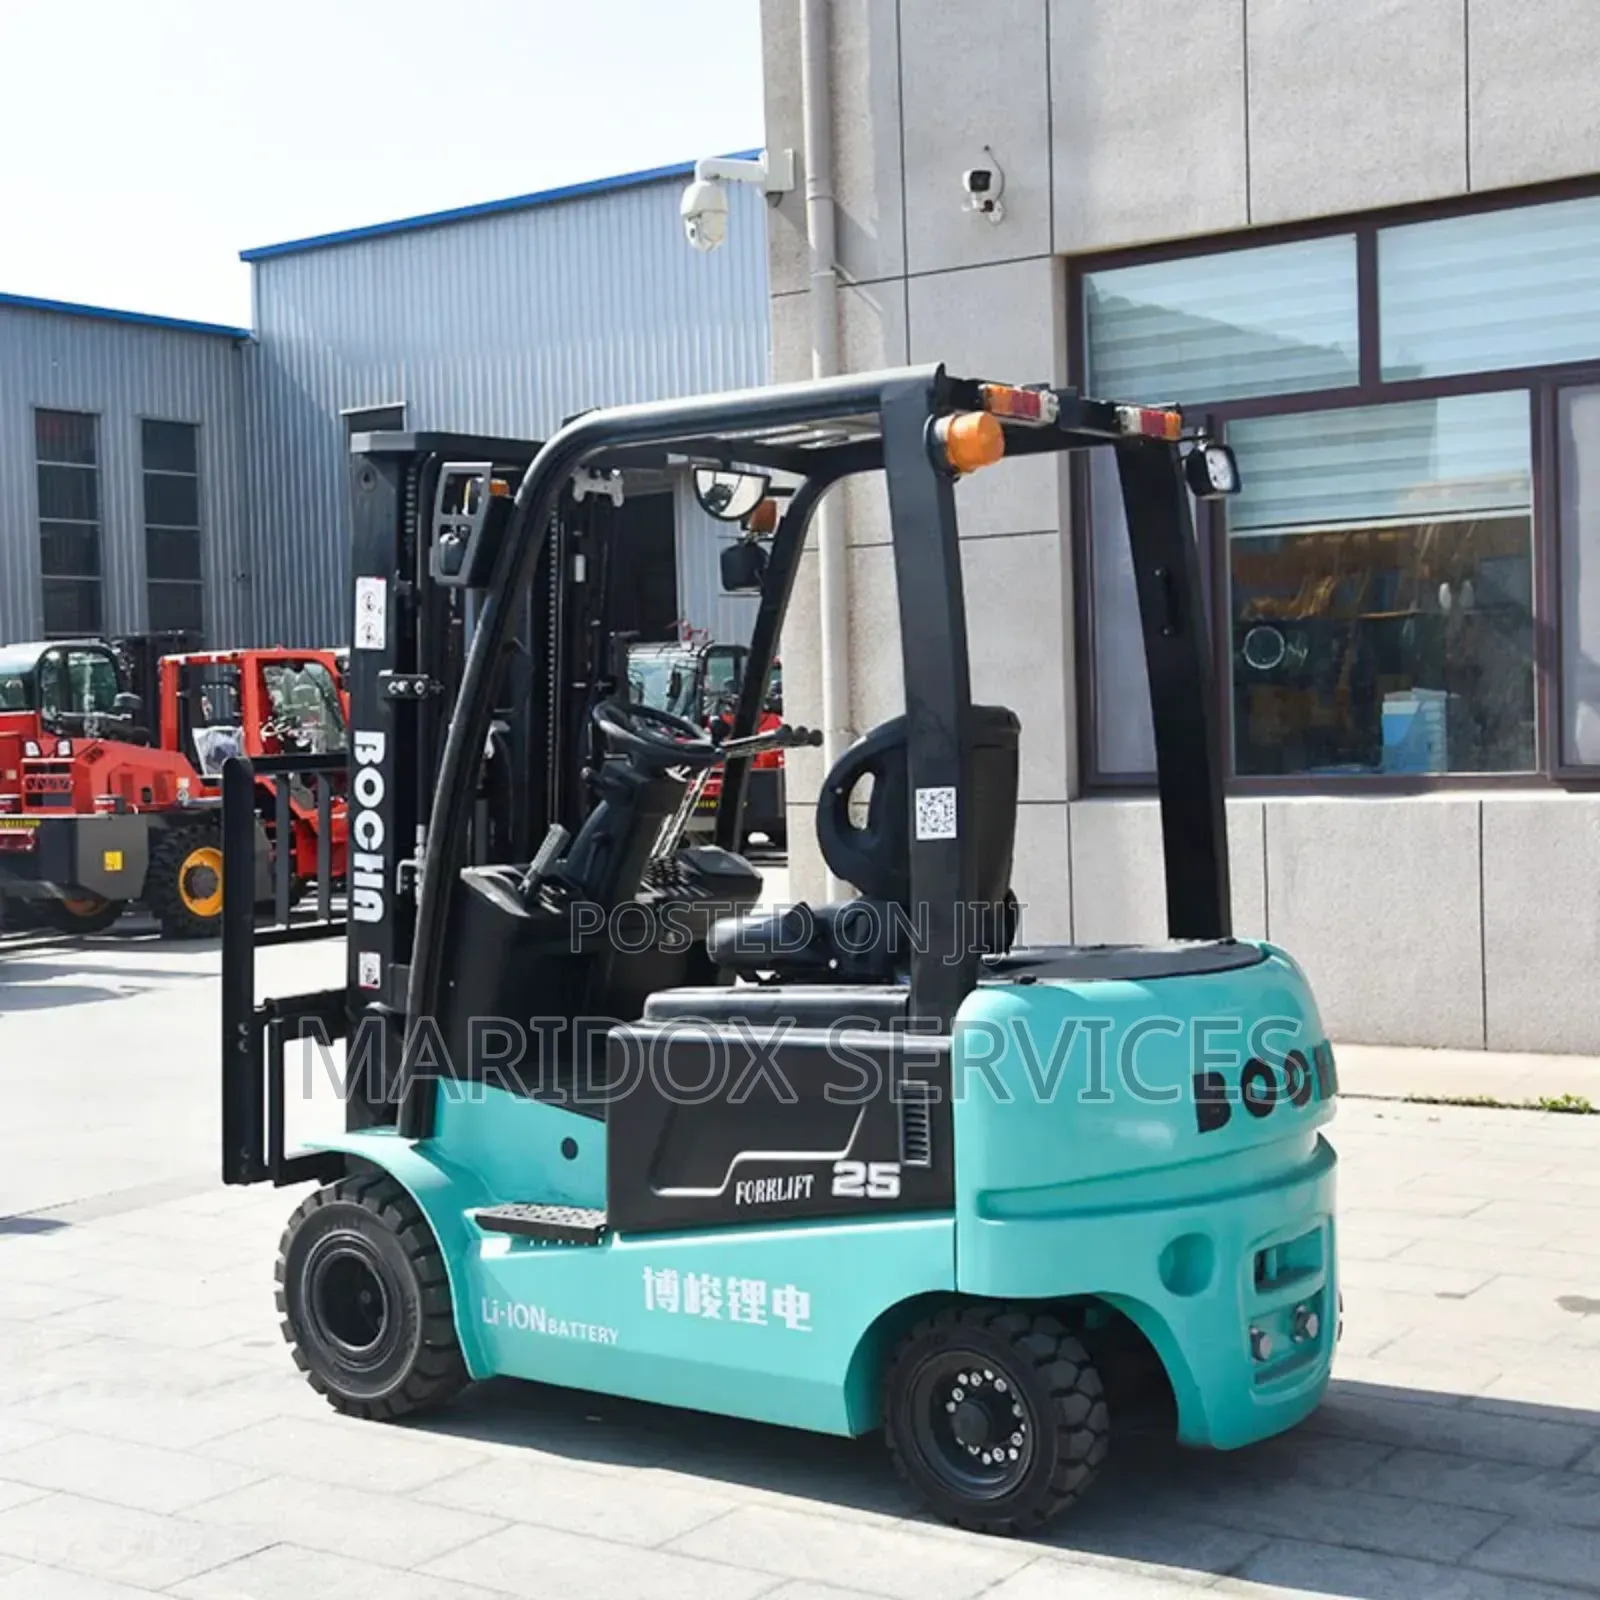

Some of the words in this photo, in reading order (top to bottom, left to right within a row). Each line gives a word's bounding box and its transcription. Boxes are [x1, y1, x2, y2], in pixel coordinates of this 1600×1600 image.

[353, 731, 385, 922] BOCHA
[735, 1174, 815, 1205] FORKLIFT
[831, 1160, 901, 1199] 25
[642, 1265, 813, 1332] 博峻锂电
[547, 1317, 620, 1345] BATTERY
